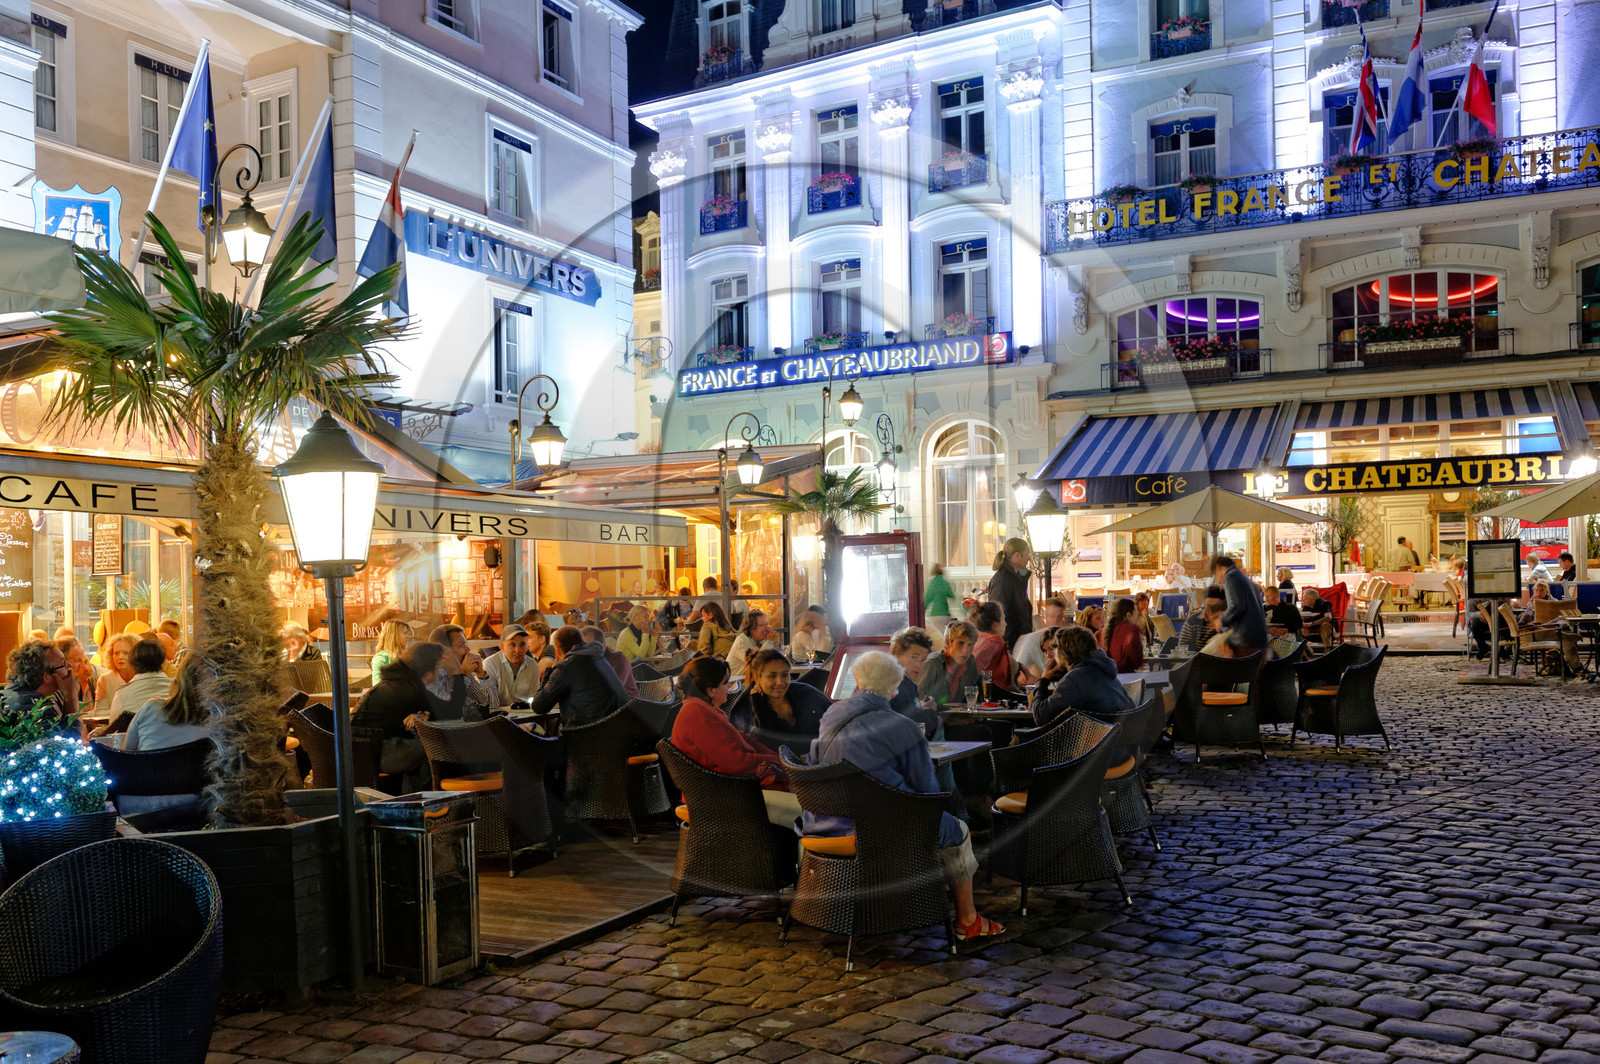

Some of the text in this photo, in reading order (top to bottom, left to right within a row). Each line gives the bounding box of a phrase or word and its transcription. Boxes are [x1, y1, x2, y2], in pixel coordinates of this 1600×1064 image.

[953, 82, 971, 93] F.C.
[831, 108, 849, 120] F.C.
[1173, 123, 1193, 135] F.C.
[1068, 199, 1176, 236] HOTEL
[1194, 175, 1342, 219] FRANCE
[1370, 163, 1401, 184] ET
[956, 242, 974, 253] F.C.
[429, 222, 587, 298] L'UNIVERS
[834, 262, 850, 273] F.C.
[681, 341, 981, 393] FRANCE ET CHATEAUBRIAND
[0, 475, 159, 512] CAFÉ
[1135, 475, 1187, 496] Café
[599, 523, 650, 542] BAR
